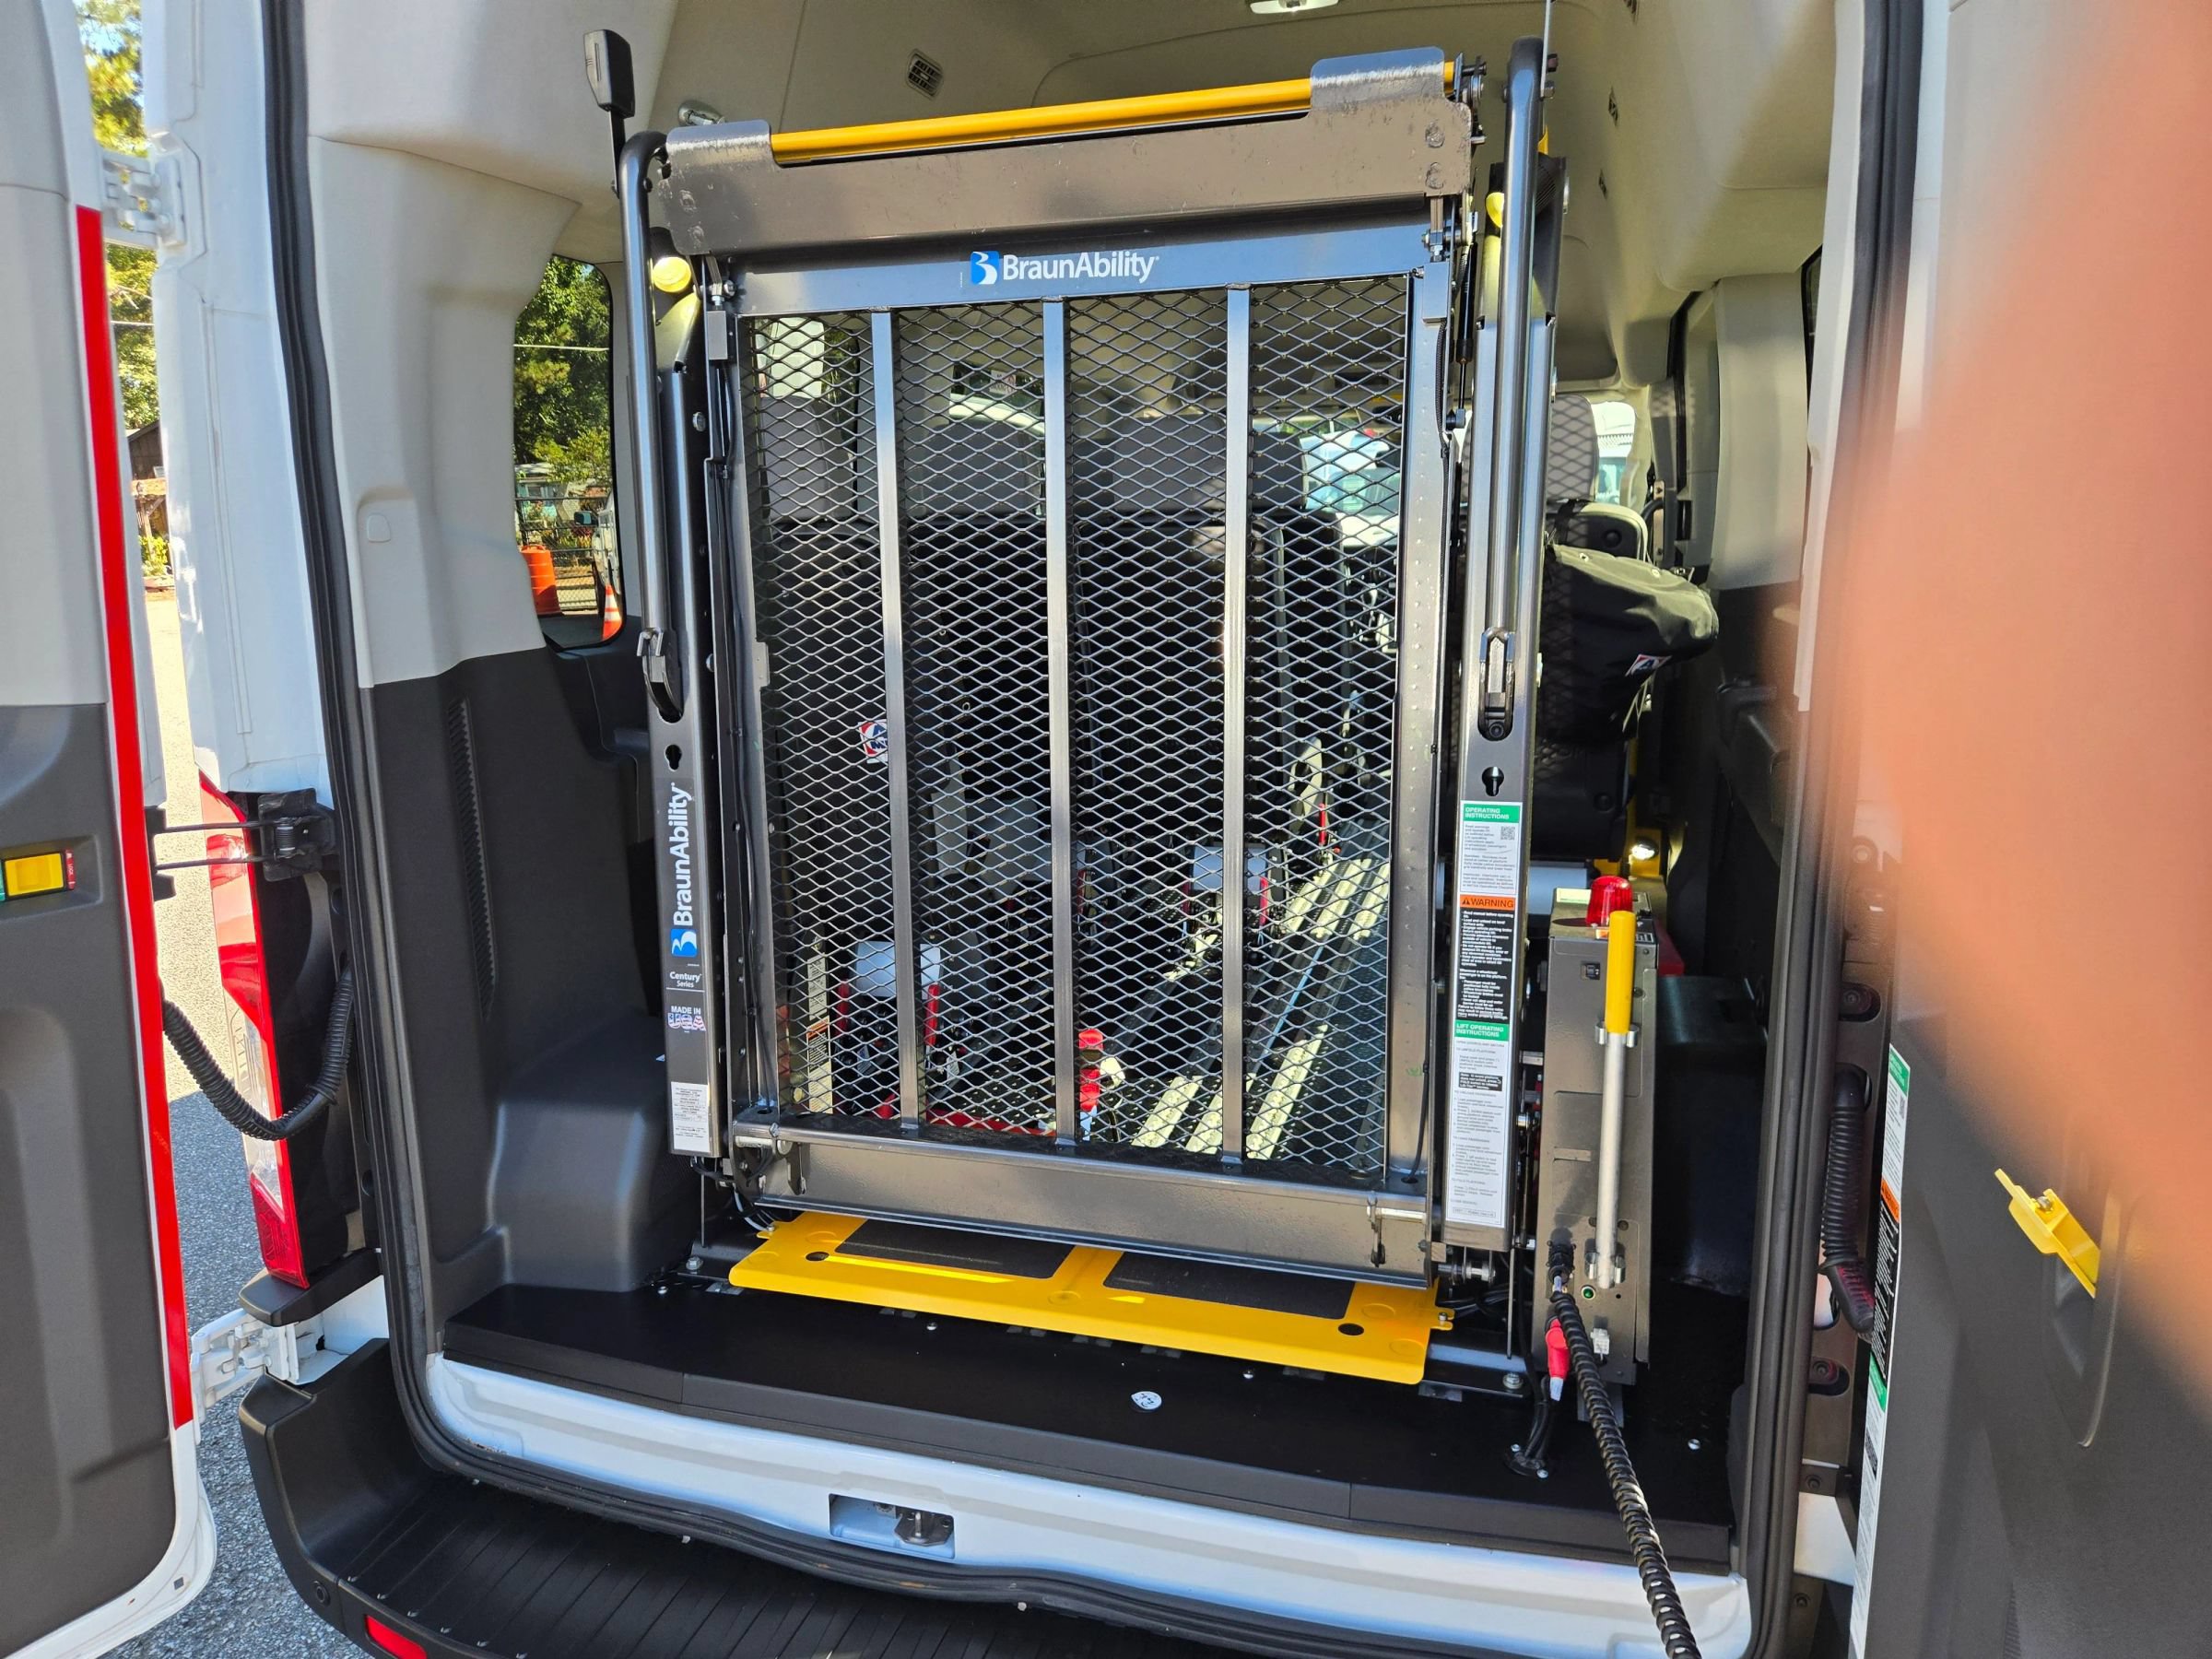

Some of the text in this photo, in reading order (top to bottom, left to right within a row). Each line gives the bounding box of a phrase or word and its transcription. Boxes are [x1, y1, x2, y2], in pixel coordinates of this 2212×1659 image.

[1003, 251, 1156, 284] BraunAbility
[669, 785, 693, 926] BraunAbility
[1471, 898, 1513, 908] WARNING
[669, 971, 701, 983] Century
[677, 980, 694, 988] Series
[671, 1006, 692, 1014] MADE
[667, 1012, 707, 1031] USA
